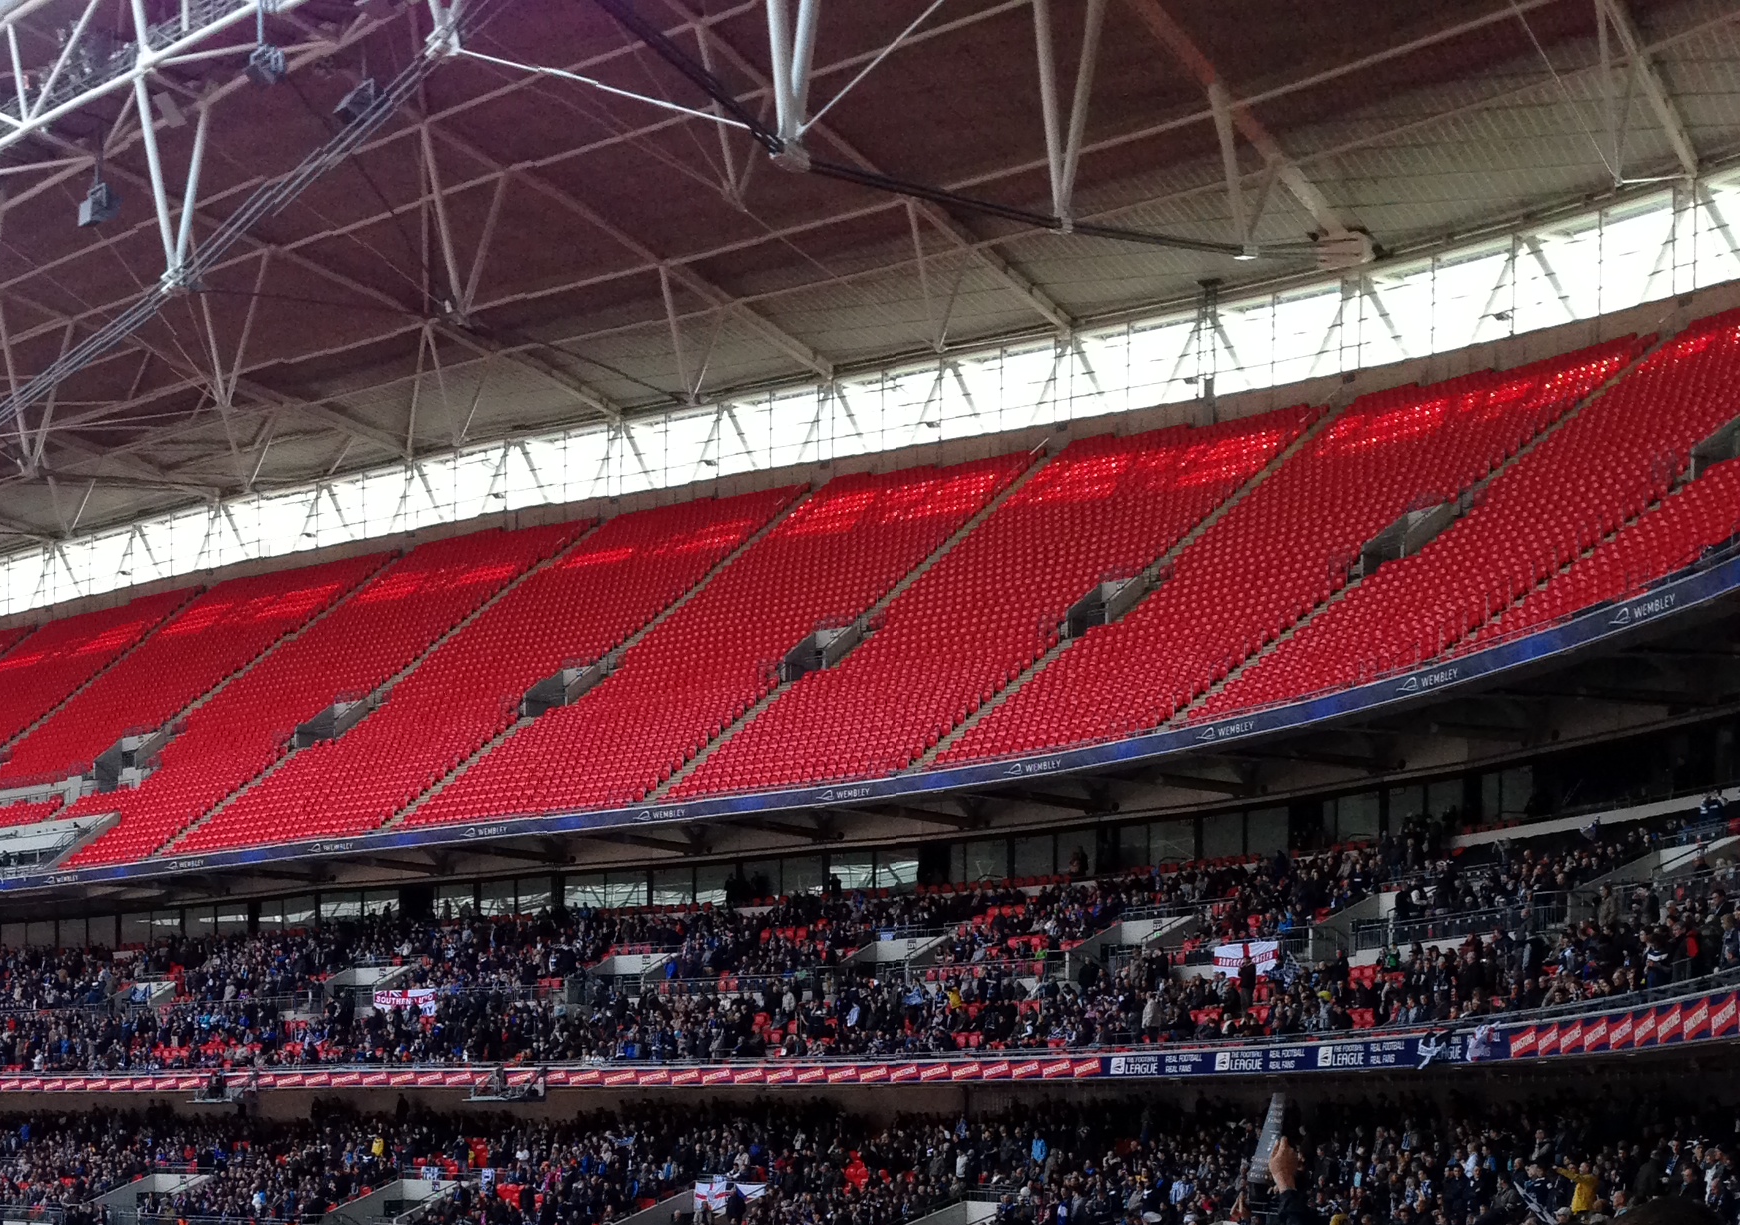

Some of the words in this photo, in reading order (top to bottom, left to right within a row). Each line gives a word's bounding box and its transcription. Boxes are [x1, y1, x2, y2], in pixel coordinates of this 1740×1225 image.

[1634, 594, 1675, 618] WEMBLEY
[1421, 669, 1458, 686] WEMBLEY
[1218, 721, 1254, 737] WEMBLEY
[1026, 760, 1061, 773] WEMBLEY
[836, 788, 870, 800] WEMBLEY
[653, 809, 685, 819] WEMBLEY
[478, 827, 508, 836] WEMBLEY
[375, 995, 413, 1004] SOUTHEN
[1384, 1041, 1404, 1050] FOOTBALL
[1270, 1050, 1282, 1058] REAL
[1283, 1048, 1305, 1057] FOOTBALL
[1383, 1054, 1395, 1062] FANS
[1165, 1056, 1178, 1064] REAL
[1179, 1054, 1202, 1062] FOOTBALL
[1230, 1058, 1262, 1070] LEAGUE
[1283, 1060, 1295, 1068] FANS
[1332, 1052, 1364, 1066] LEAGUE
[1126, 1062, 1158, 1074] LEAGUE
[1165, 1066, 1178, 1074] REAL
